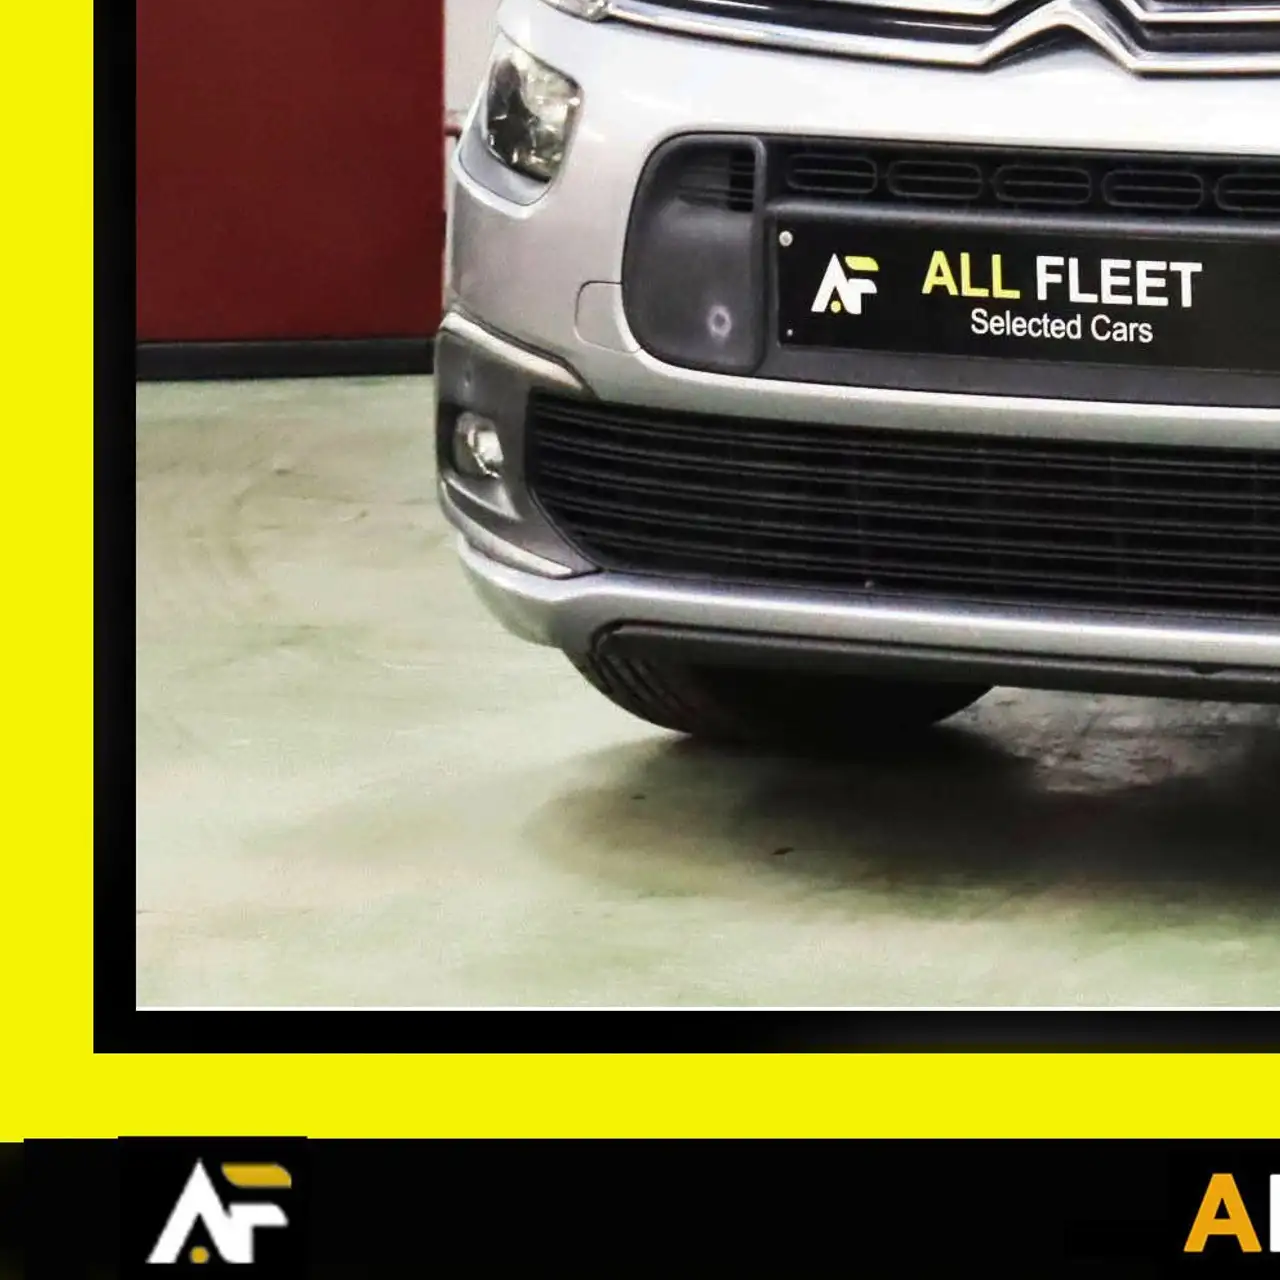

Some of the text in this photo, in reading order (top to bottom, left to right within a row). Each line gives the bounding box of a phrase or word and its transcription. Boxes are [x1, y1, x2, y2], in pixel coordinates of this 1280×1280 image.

[810, 250, 1203, 315] AF ALL FLEET
[970, 307, 1154, 345] Selected Cars
